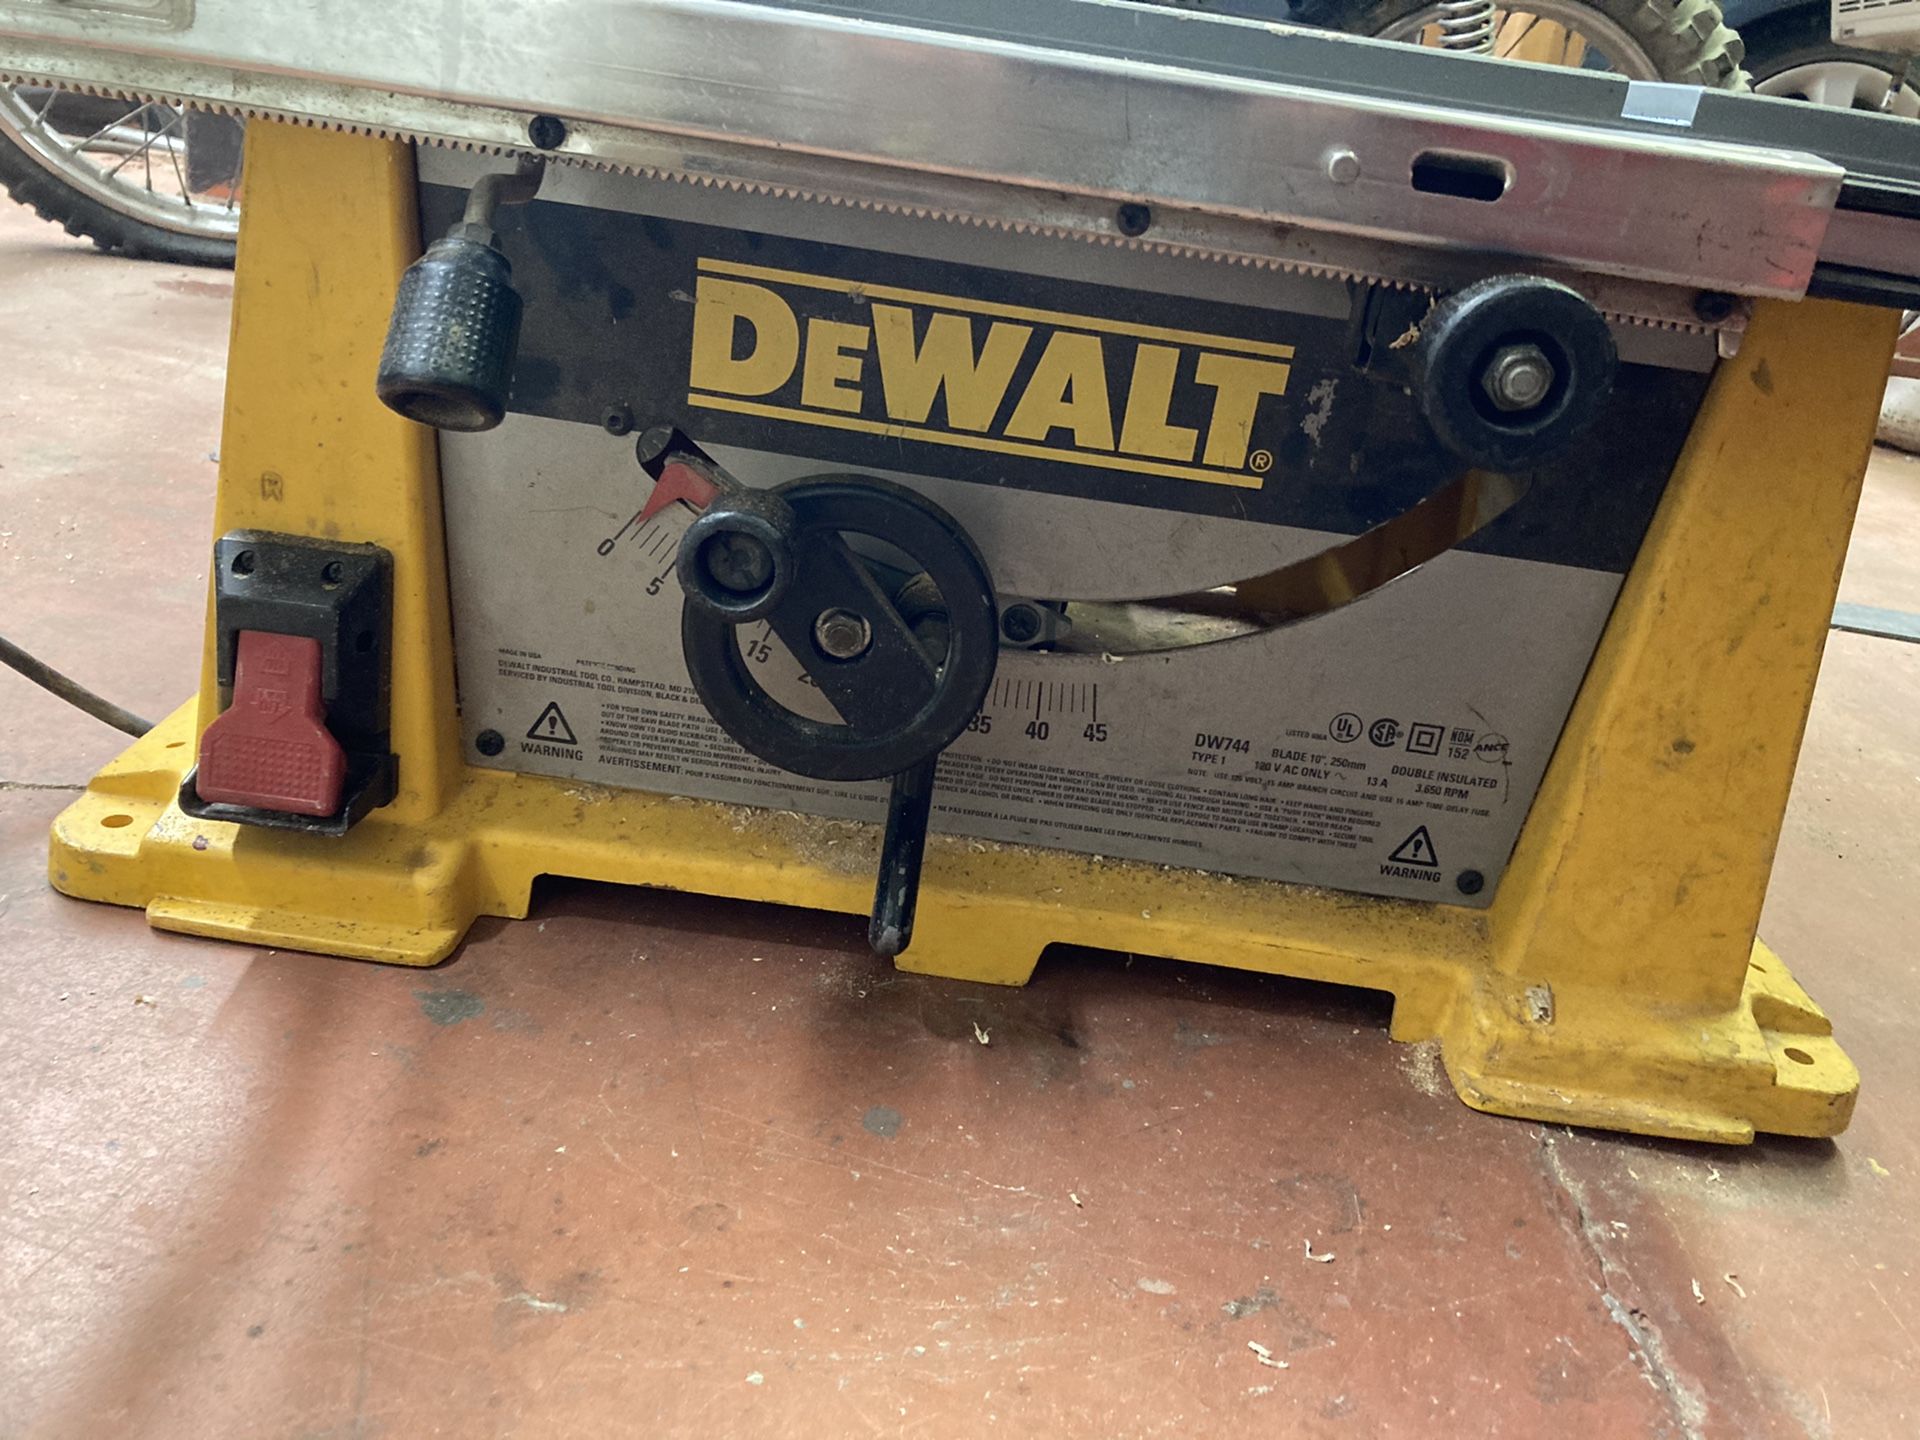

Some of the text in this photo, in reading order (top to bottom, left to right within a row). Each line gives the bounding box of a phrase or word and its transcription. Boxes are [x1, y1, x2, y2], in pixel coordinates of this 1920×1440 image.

[646, 577, 663, 596] 5
[746, 639, 773, 663] 15
[532, 664, 577, 677] INDUSTRIAL
[579, 671, 597, 680] TOOL
[549, 676, 594, 688] INDUSTRIAL
[597, 683, 615, 692] TOOL
[655, 692, 679, 701] BLACK
[621, 705, 639, 713] YOUR
[640, 708, 657, 716] OWN
[606, 720, 626, 728] KNOW
[629, 723, 645, 731] HOW
[658, 719, 680, 728] BLADE
[968, 714, 992, 734] 35
[1025, 721, 1049, 740] 40
[1083, 723, 1107, 742] 45
[660, 736, 676, 744] SAW
[1451, 729, 1474, 744] NOM
[520, 742, 584, 761] WARNING
[1194, 732, 1250, 754] DW744
[1271, 747, 1307, 762] BLADE
[1448, 747, 1470, 760] 152
[1191, 751, 1217, 763] TYPE
[1272, 762, 1281, 772] V
[1282, 764, 1299, 775] AC
[1300, 766, 1330, 780] ONLY
[1391, 764, 1498, 789] DOUBLE INSULATED
[1366, 775, 1378, 786] 13
[1379, 777, 1389, 788] A
[1443, 787, 1469, 800] RPM
[1380, 864, 1441, 882] WARNING
